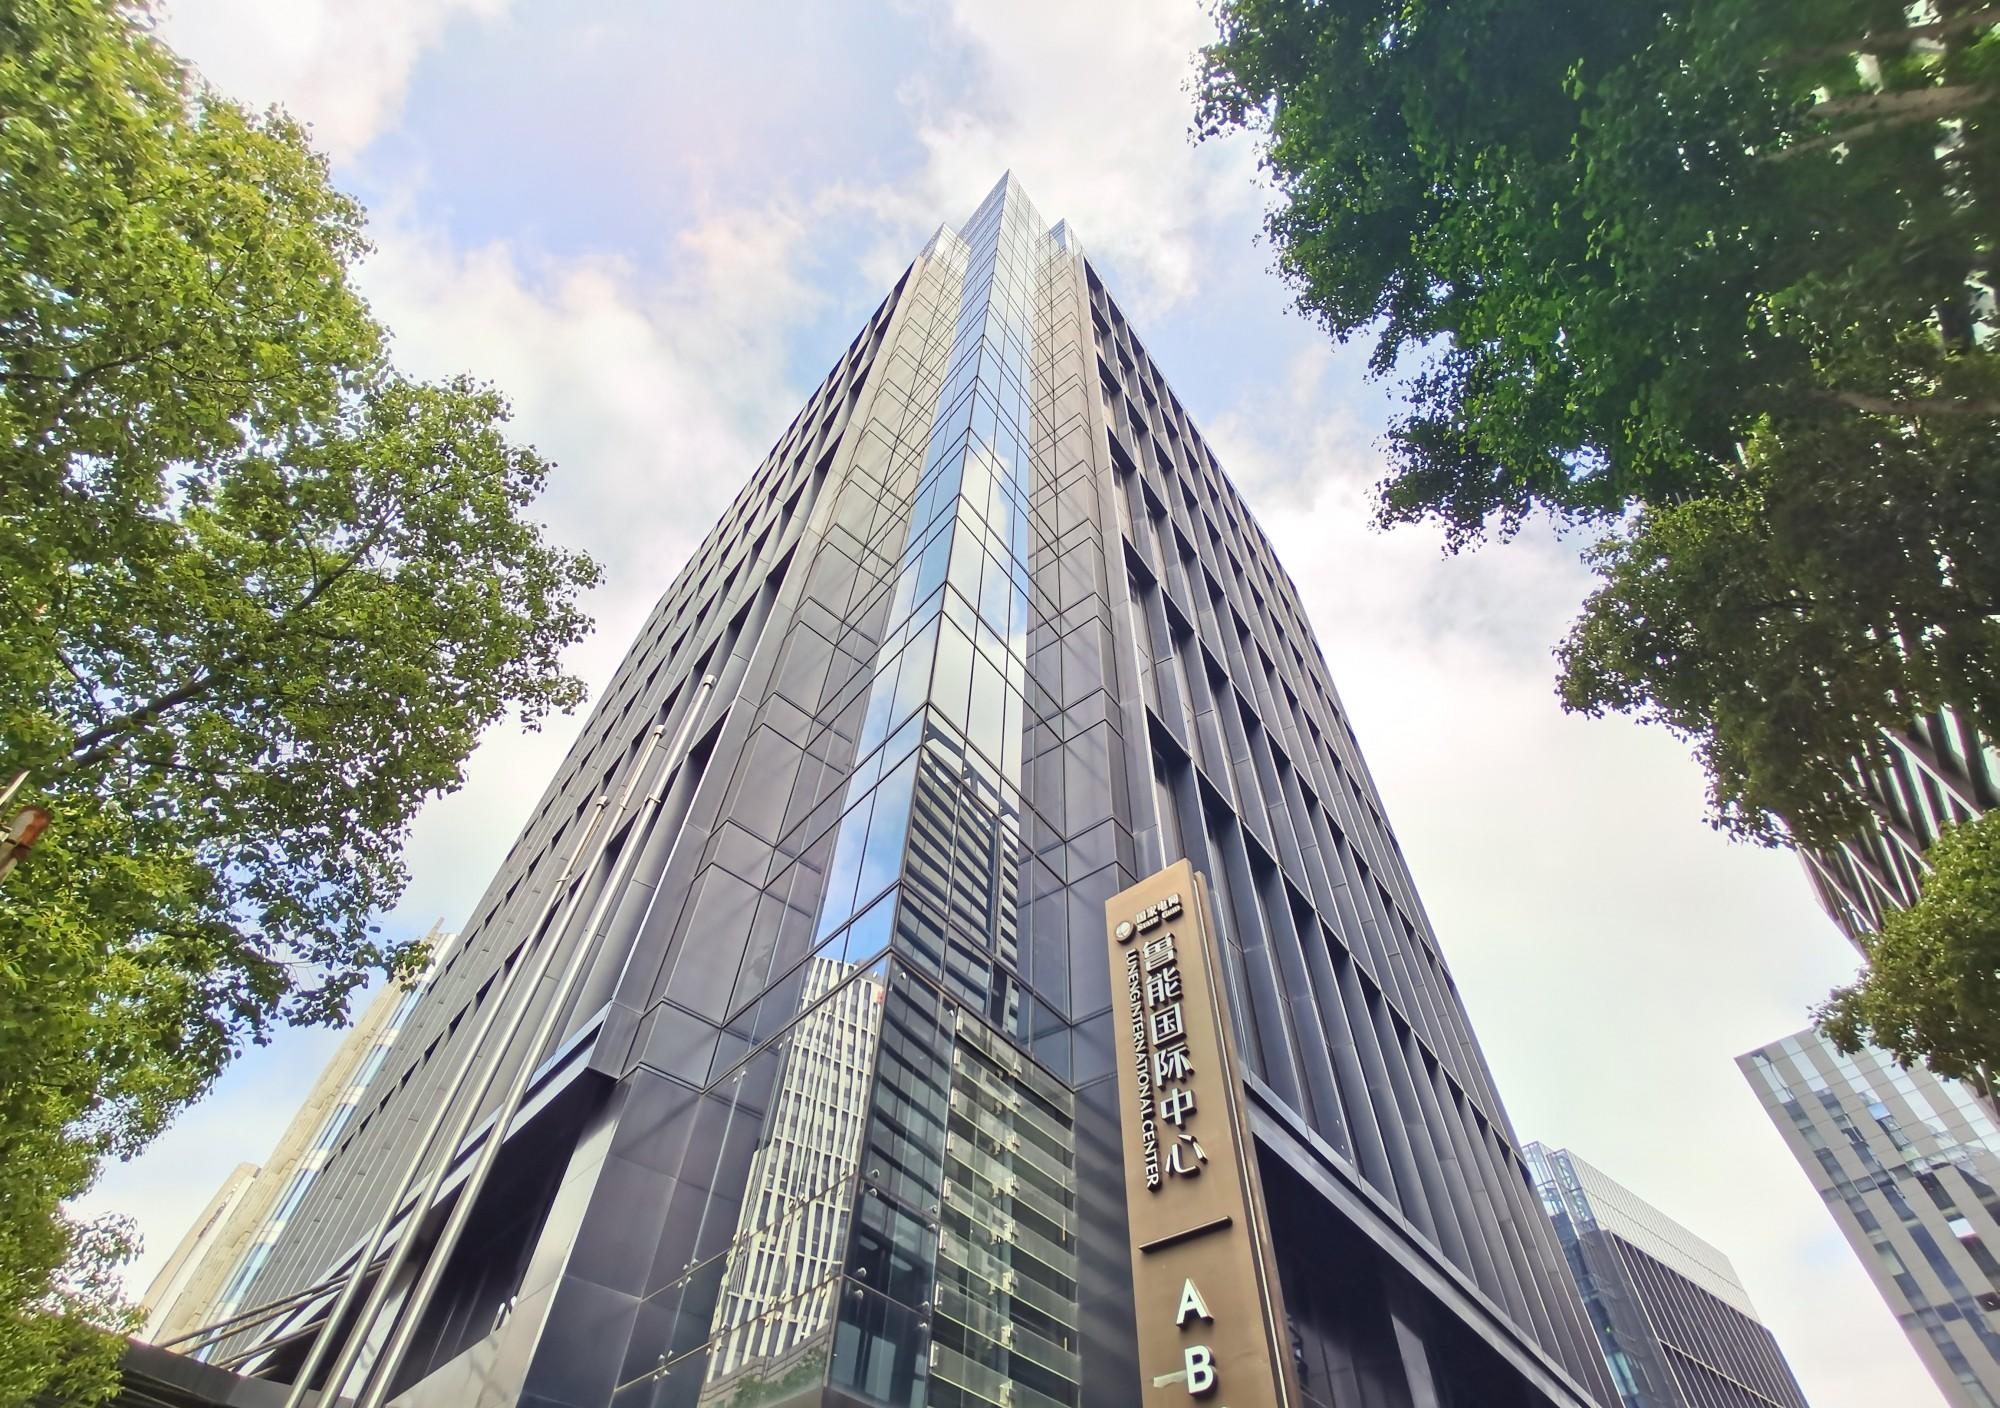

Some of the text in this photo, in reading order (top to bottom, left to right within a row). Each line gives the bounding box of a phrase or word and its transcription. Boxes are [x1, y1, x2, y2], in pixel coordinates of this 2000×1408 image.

[1126, 949, 1159, 1188] LUNENG INTERNATIONAL CENTER
[1143, 932, 1207, 1174] 鲁能国际中心
[1176, 1278, 1214, 1326] A
[1184, 1345, 1216, 1394] B
